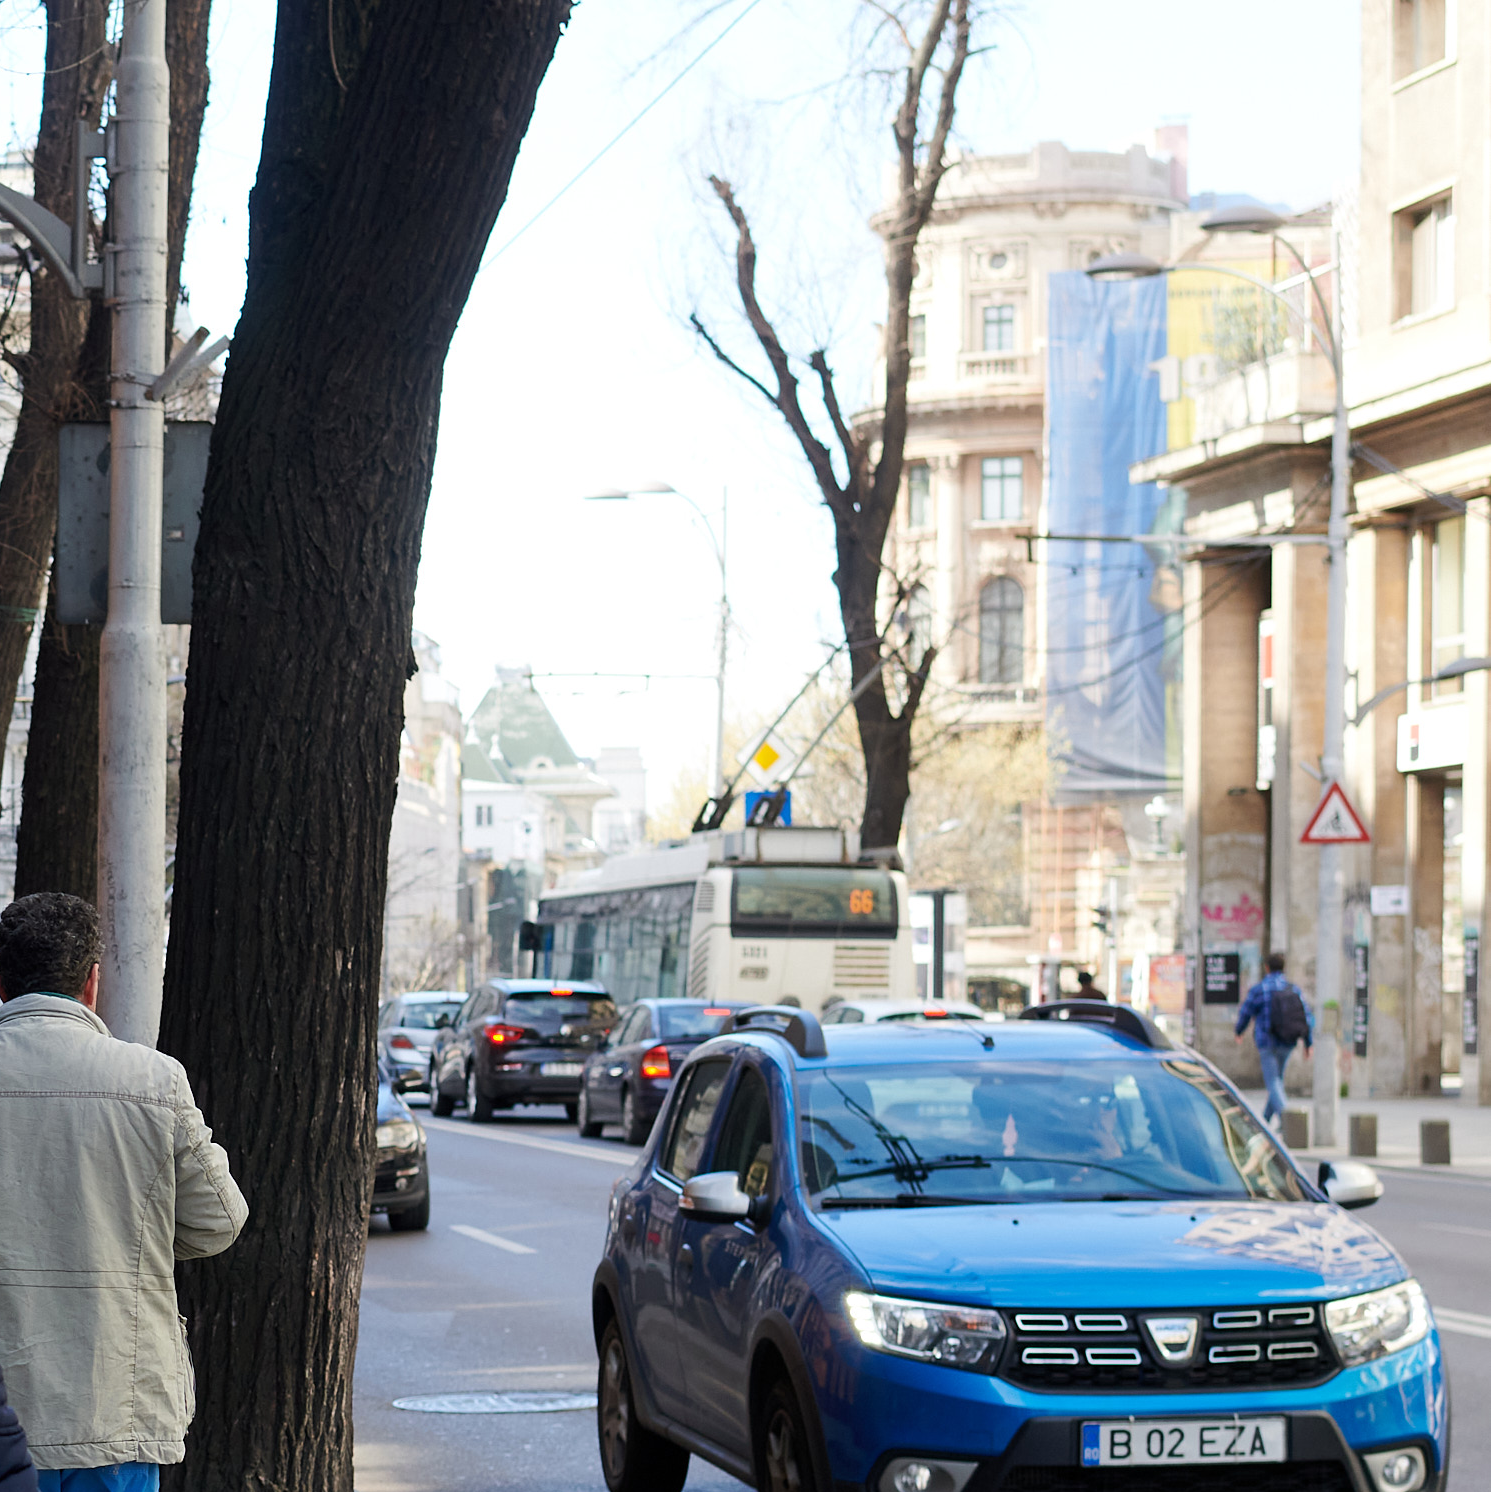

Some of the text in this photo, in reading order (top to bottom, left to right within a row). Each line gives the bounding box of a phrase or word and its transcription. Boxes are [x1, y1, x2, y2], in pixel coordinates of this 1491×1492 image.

[849, 889, 873, 914] 66
[1084, 1448, 1099, 1460] RO
[1110, 1425, 1266, 1459] B 02 EZA
